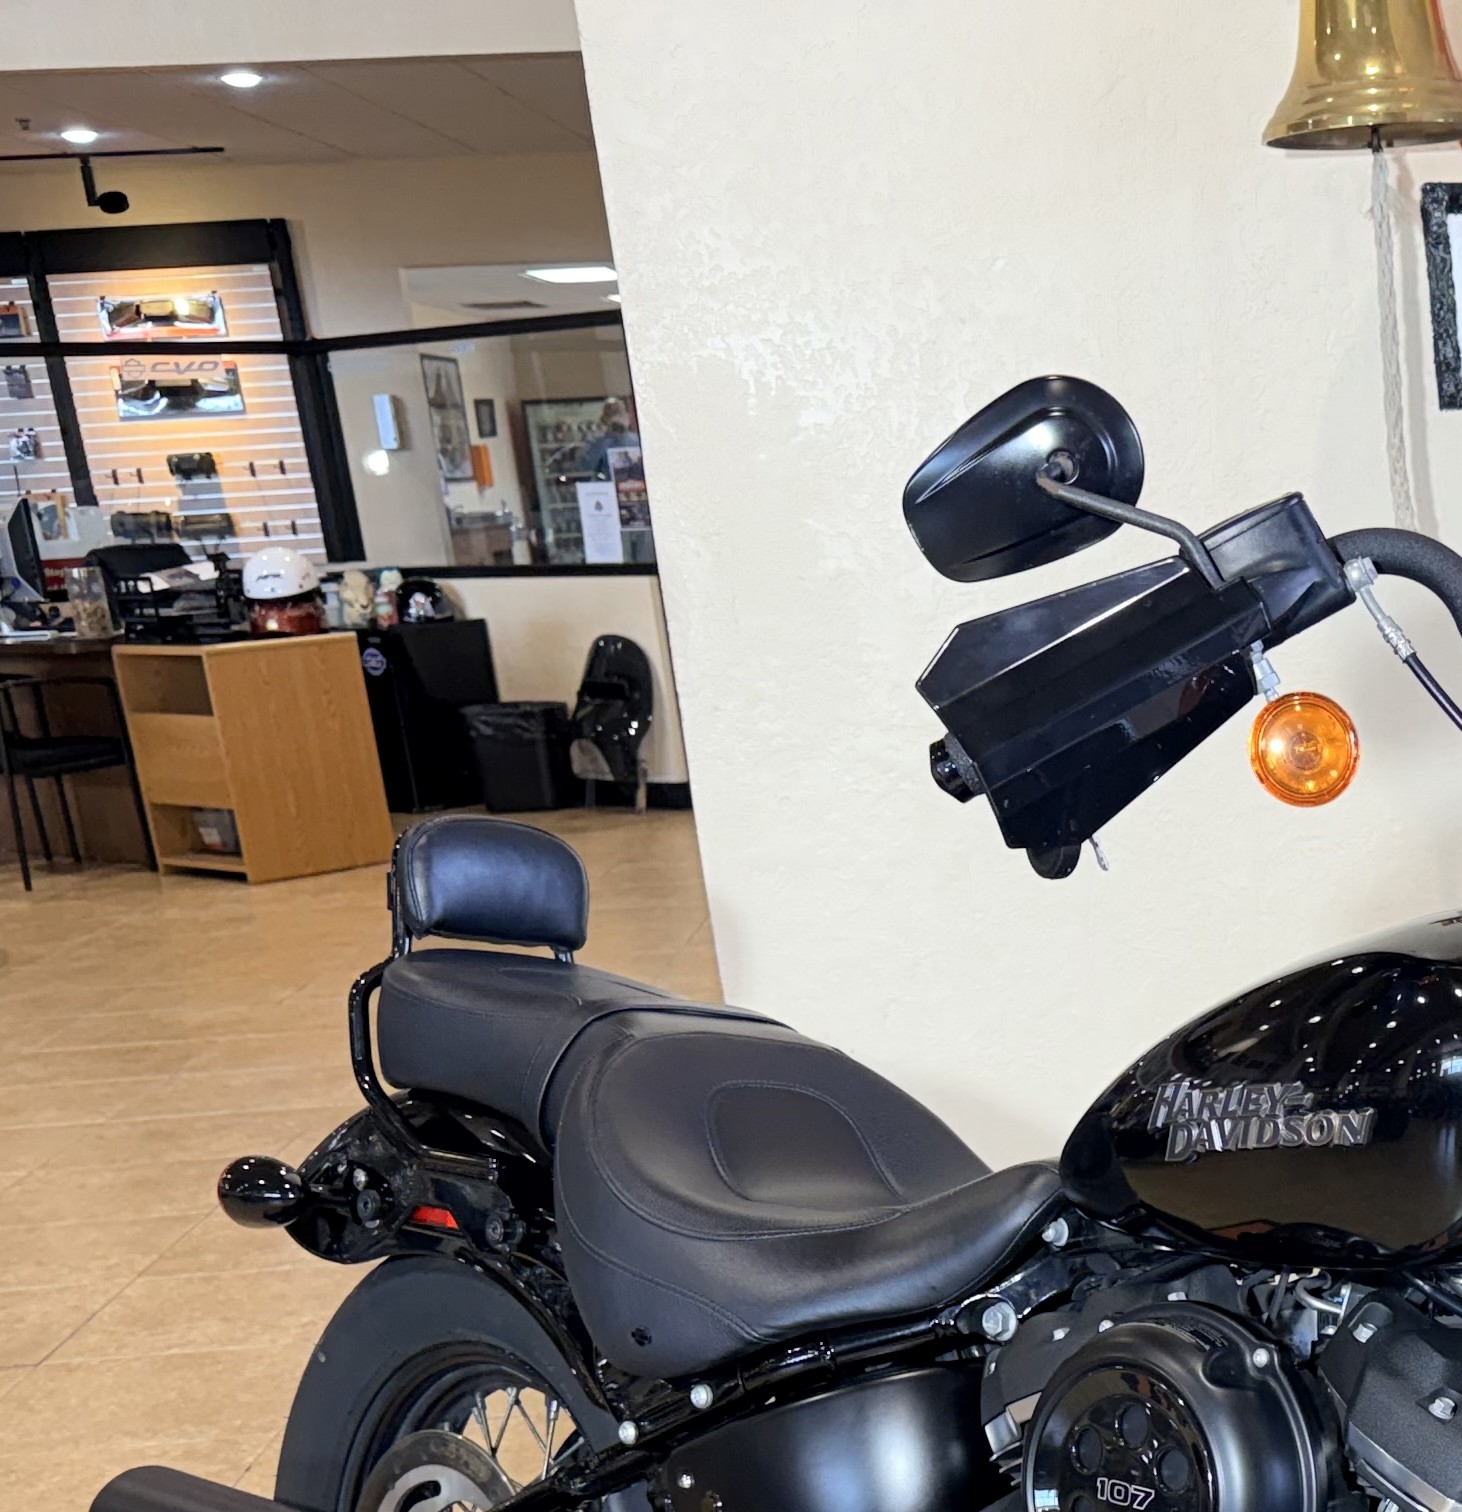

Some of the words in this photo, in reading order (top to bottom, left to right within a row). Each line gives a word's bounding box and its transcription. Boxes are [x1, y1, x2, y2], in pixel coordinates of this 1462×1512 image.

[150, 360, 220, 375] CVO
[1165, 1106, 1376, 1162] DAVIDSON
[1095, 1476, 1156, 1511] 107
